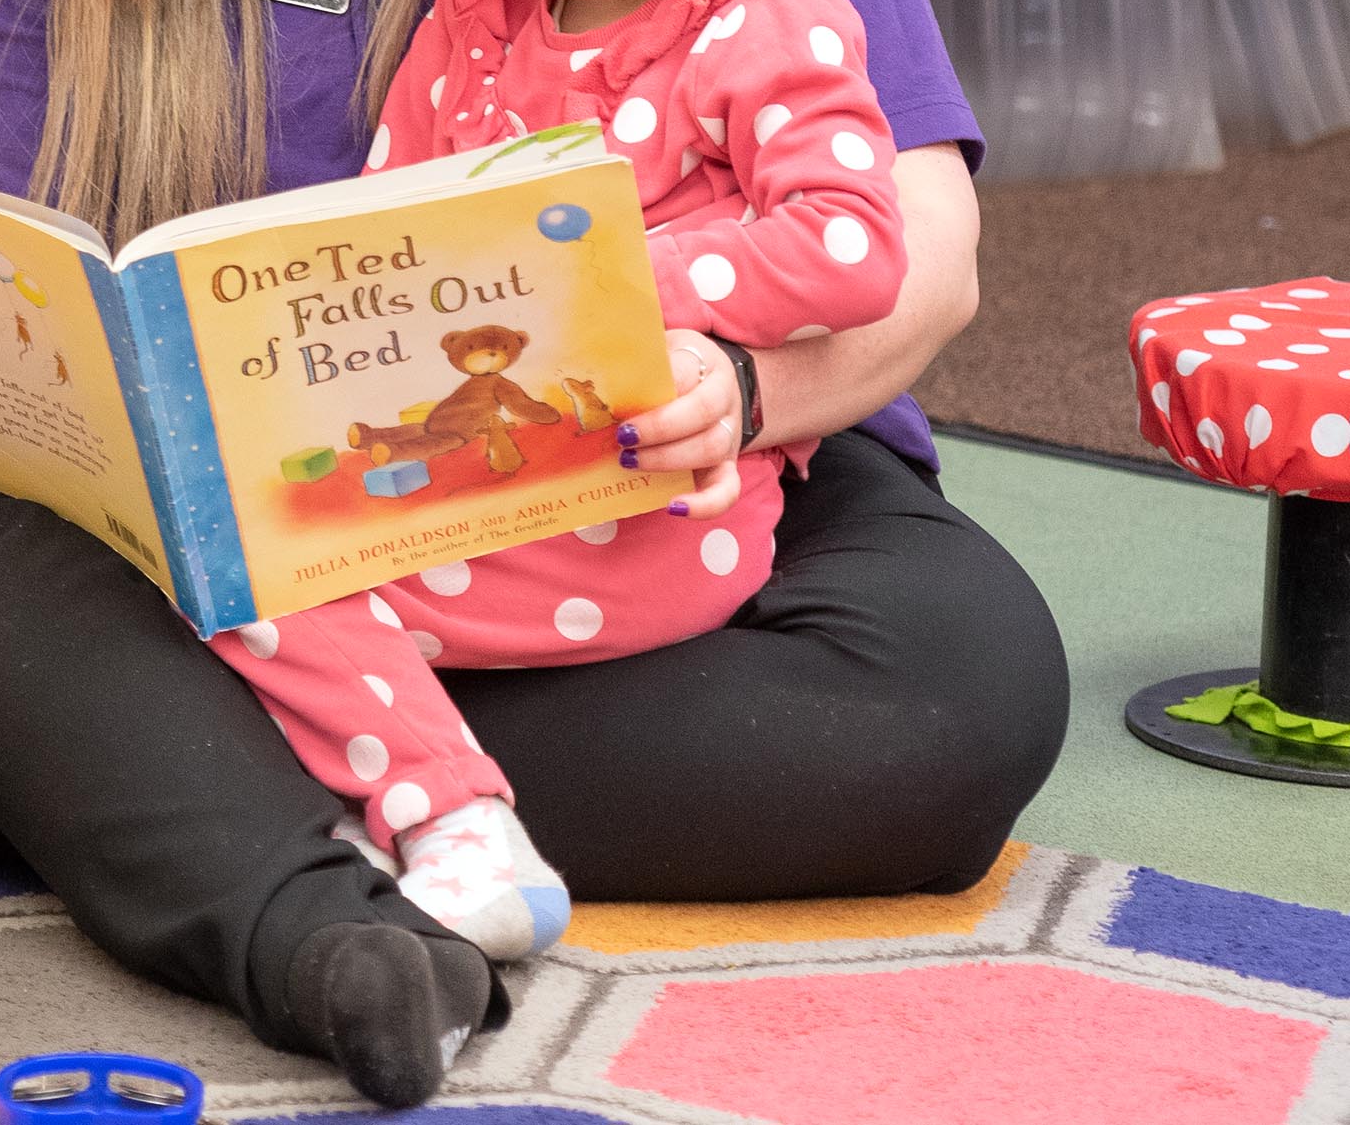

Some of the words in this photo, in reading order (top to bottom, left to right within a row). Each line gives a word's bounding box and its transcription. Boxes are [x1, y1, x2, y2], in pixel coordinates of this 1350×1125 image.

[212, 261, 311, 303] One
[316, 235, 426, 283] Ted
[287, 284, 414, 339] Falls
[430, 264, 534, 314] Out
[241, 336, 281, 380] of
[299, 330, 412, 386] Bed
[293, 556, 350, 584] JULIA
[357, 520, 471, 563] DONALDSON
[480, 514, 507, 529] AND
[516, 498, 570, 522] ANNA
[577, 475, 654, 505] CURREY
